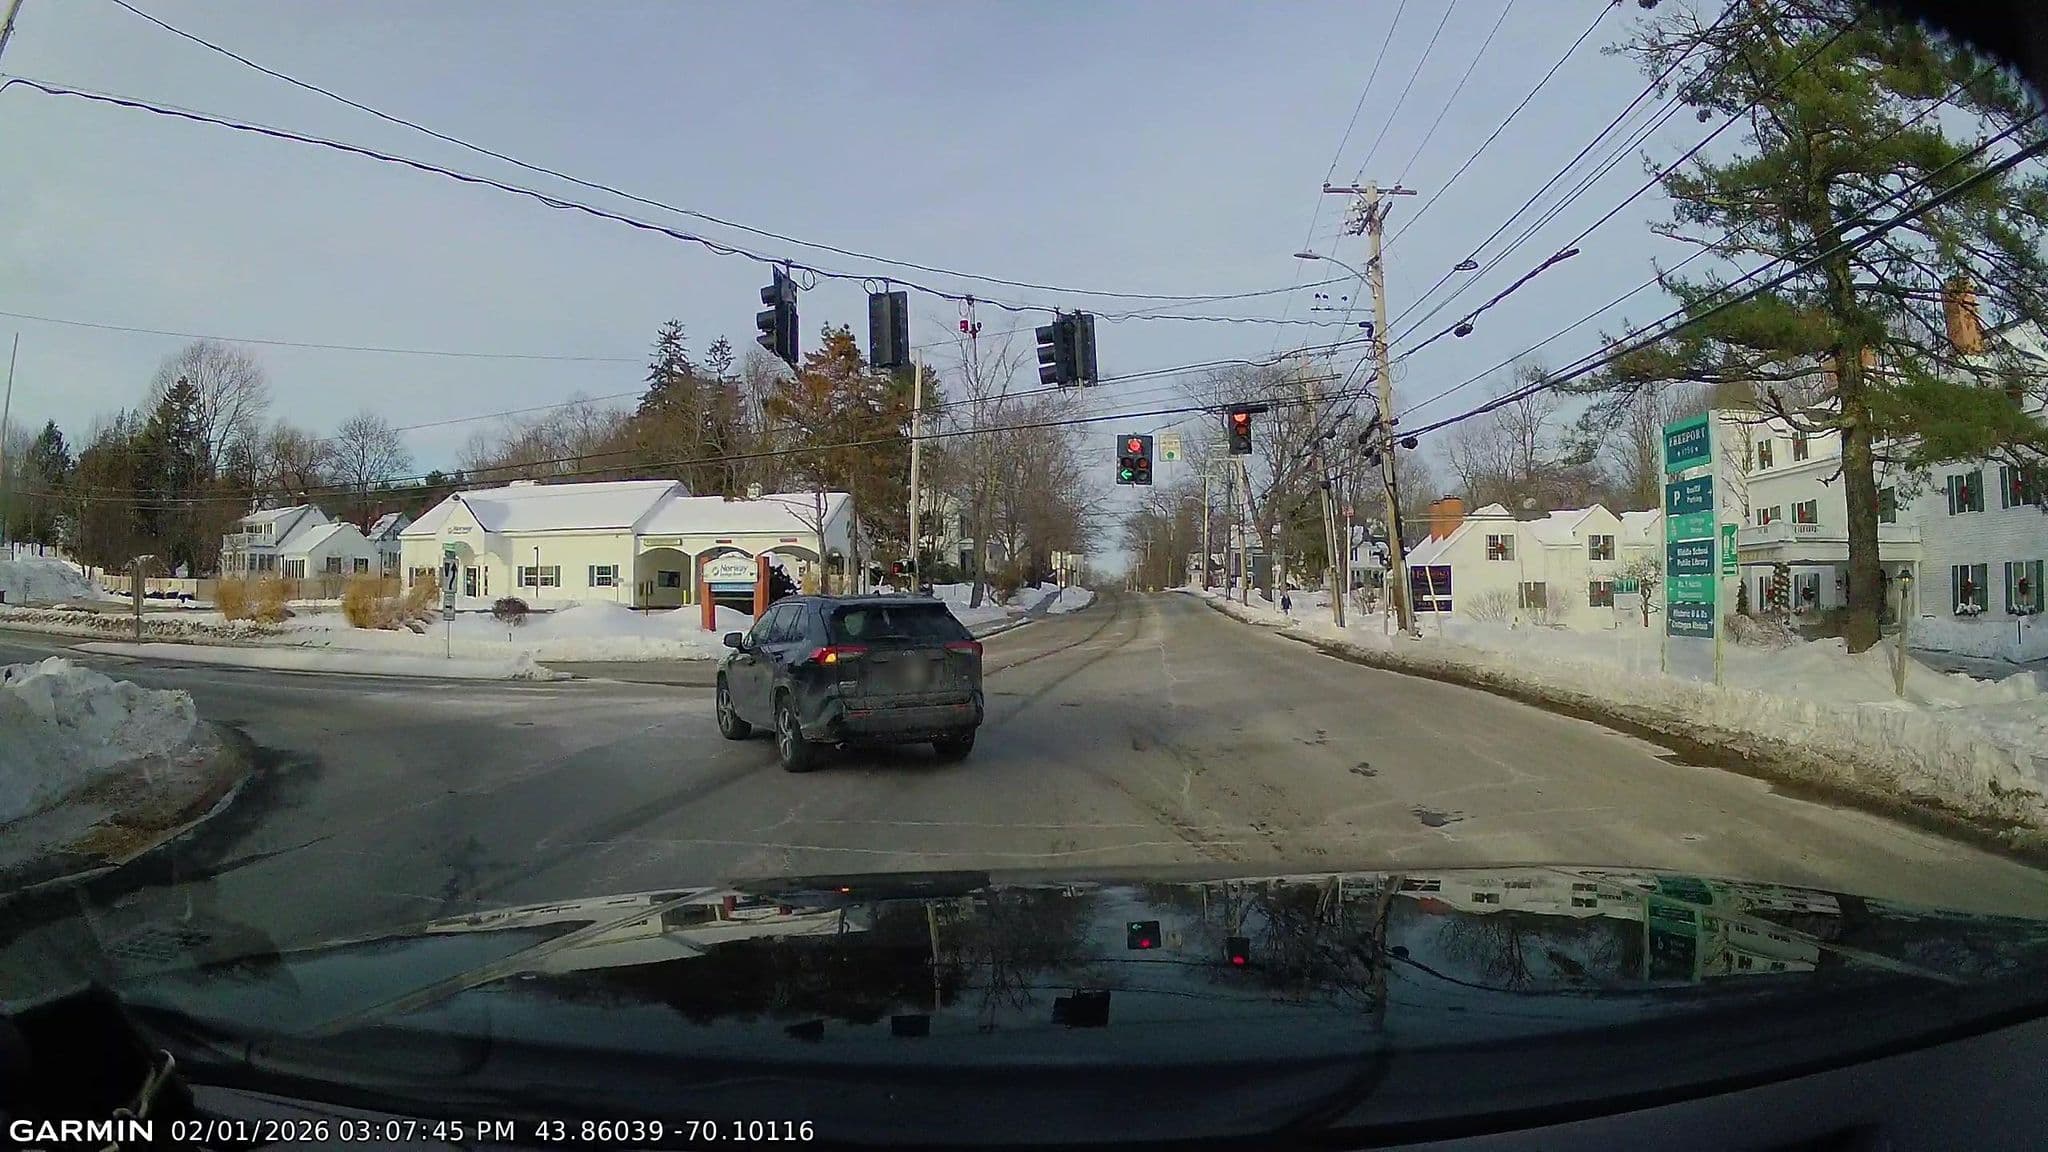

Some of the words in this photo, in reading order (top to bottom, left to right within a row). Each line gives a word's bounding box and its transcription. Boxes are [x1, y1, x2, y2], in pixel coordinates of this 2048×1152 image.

[1669, 427, 1705, 447] FREEPORT
[1673, 490, 1681, 506] P
[1692, 546, 1708, 555] School
[1691, 558, 1708, 567] Library
[720, 564, 748, 574] Norway
